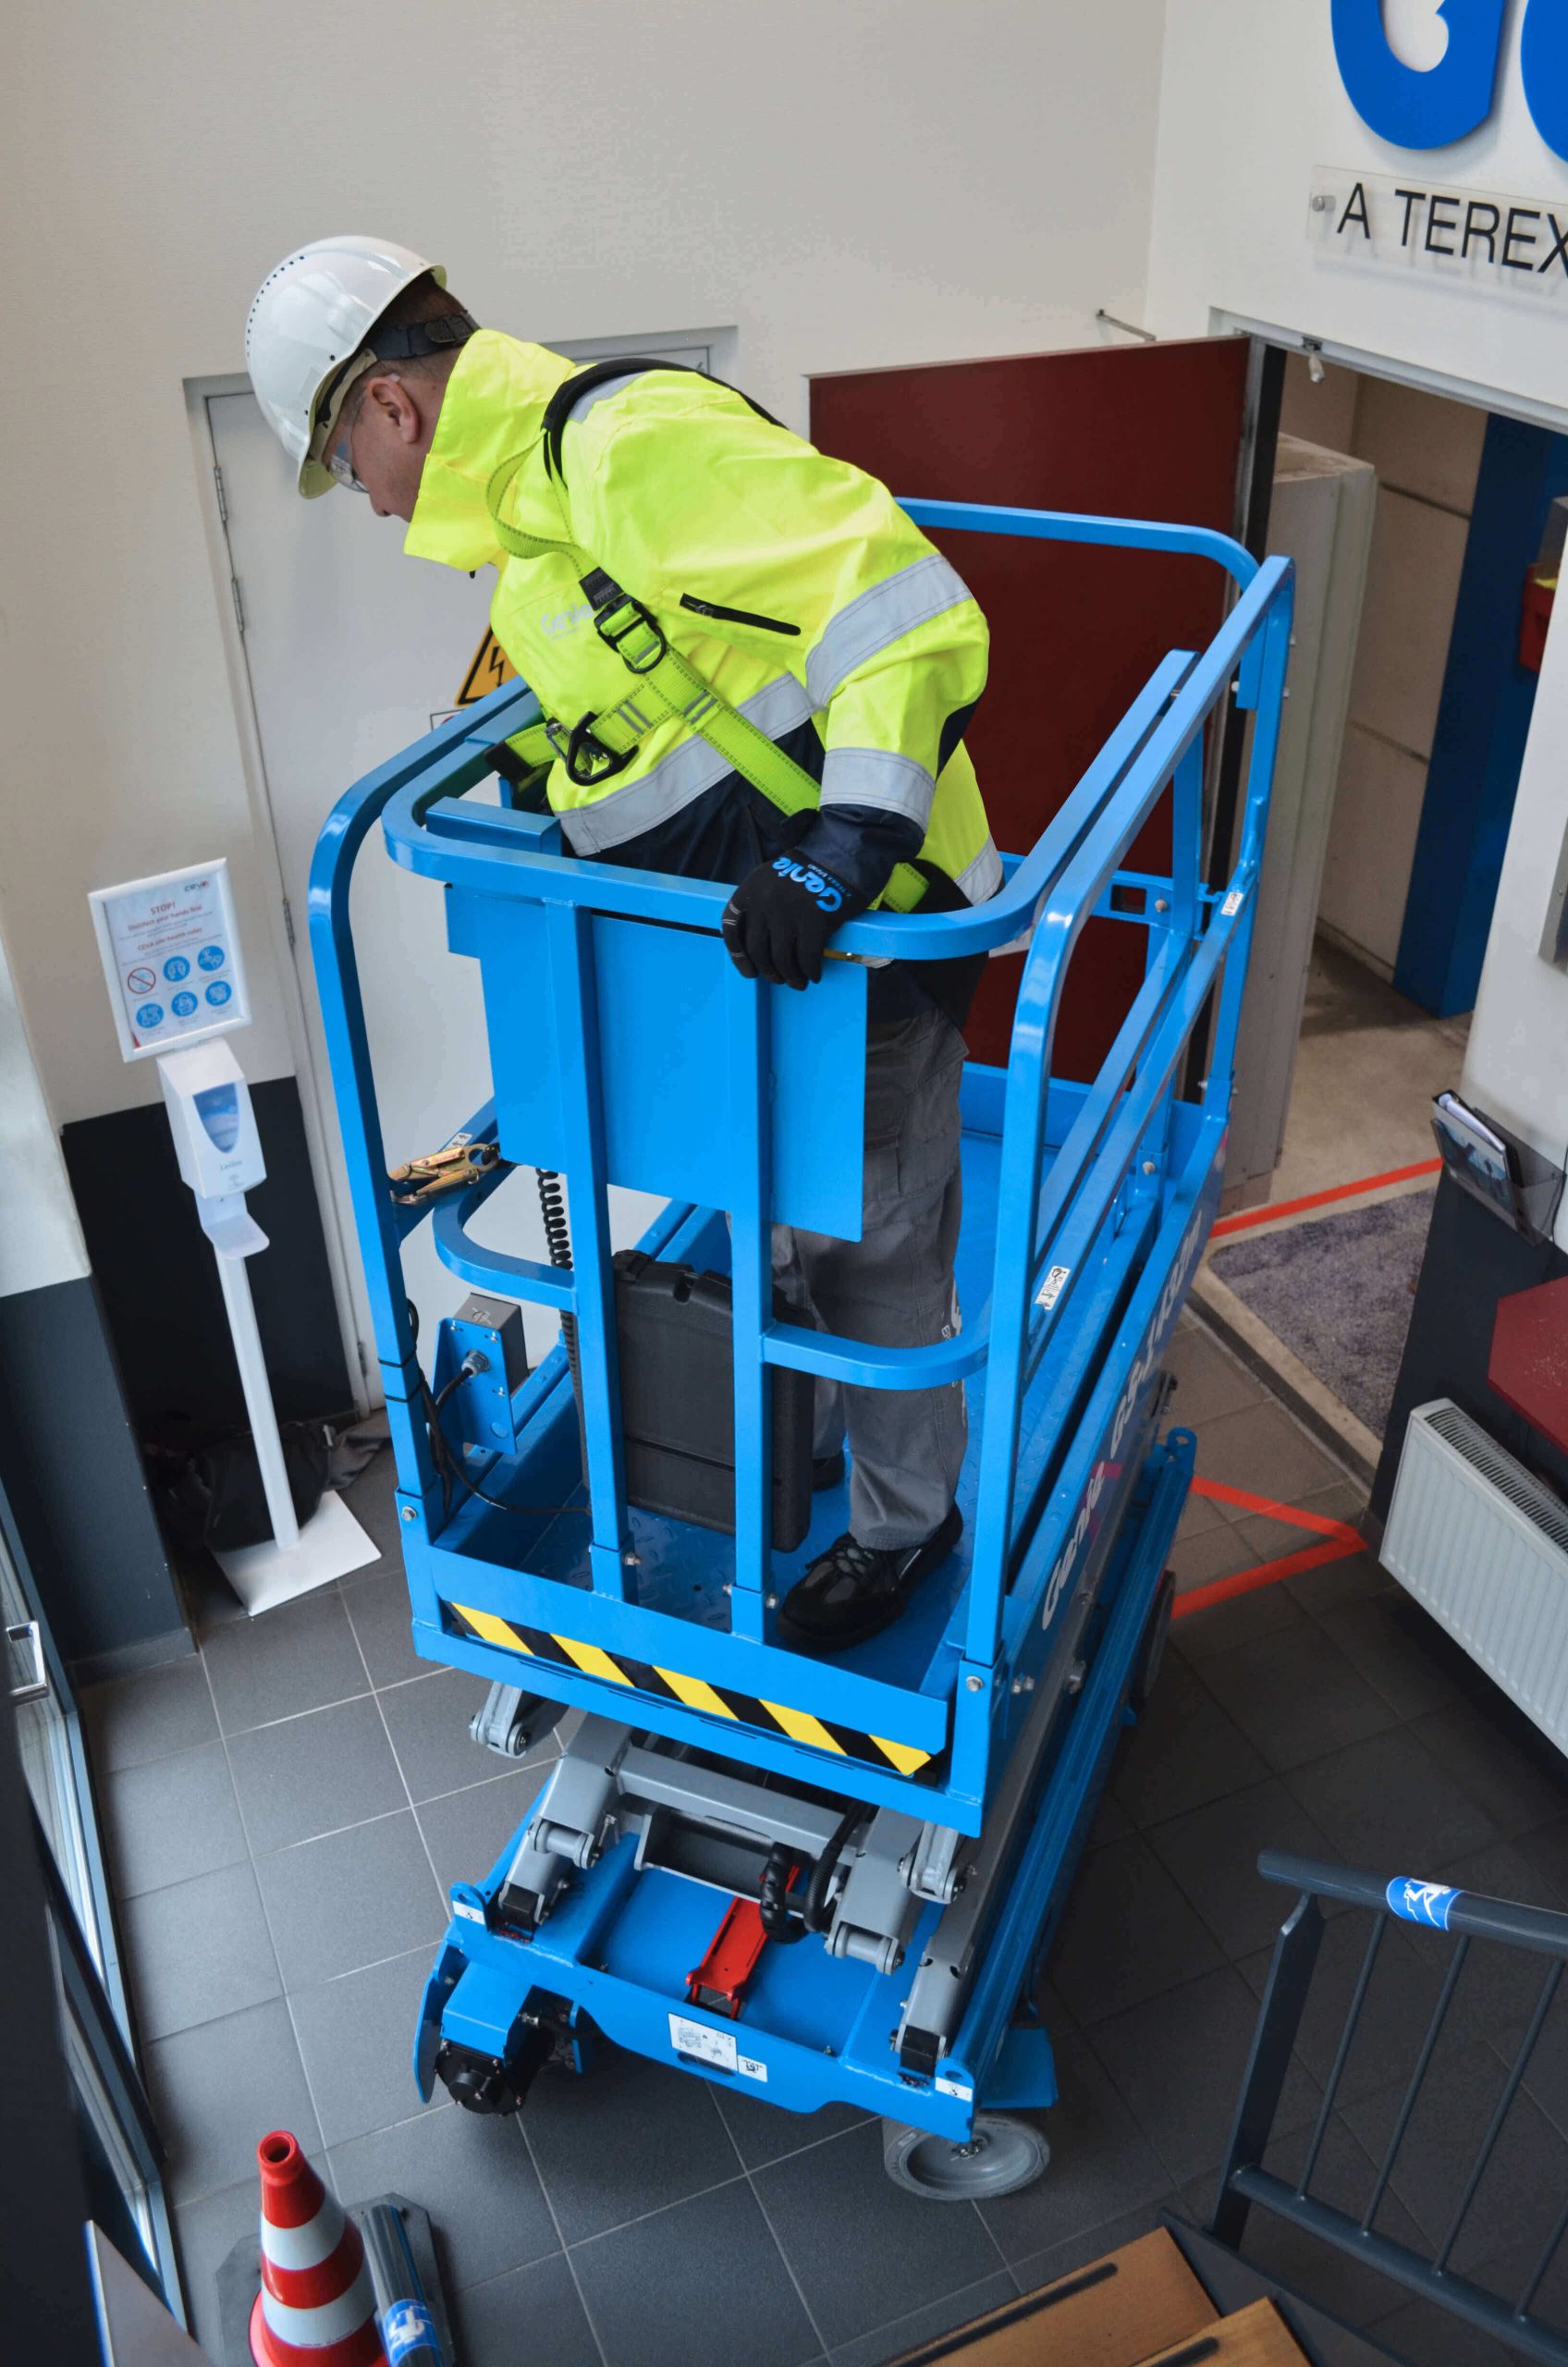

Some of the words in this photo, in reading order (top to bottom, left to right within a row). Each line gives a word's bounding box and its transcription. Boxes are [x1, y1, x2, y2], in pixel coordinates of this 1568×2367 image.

[1337, 182, 1371, 239] A
[1394, 189, 1568, 279] TEREX
[150, 901, 176, 915] STOP!
[771, 856, 843, 913] Genie
[1042, 1461, 1105, 1631] Genie
